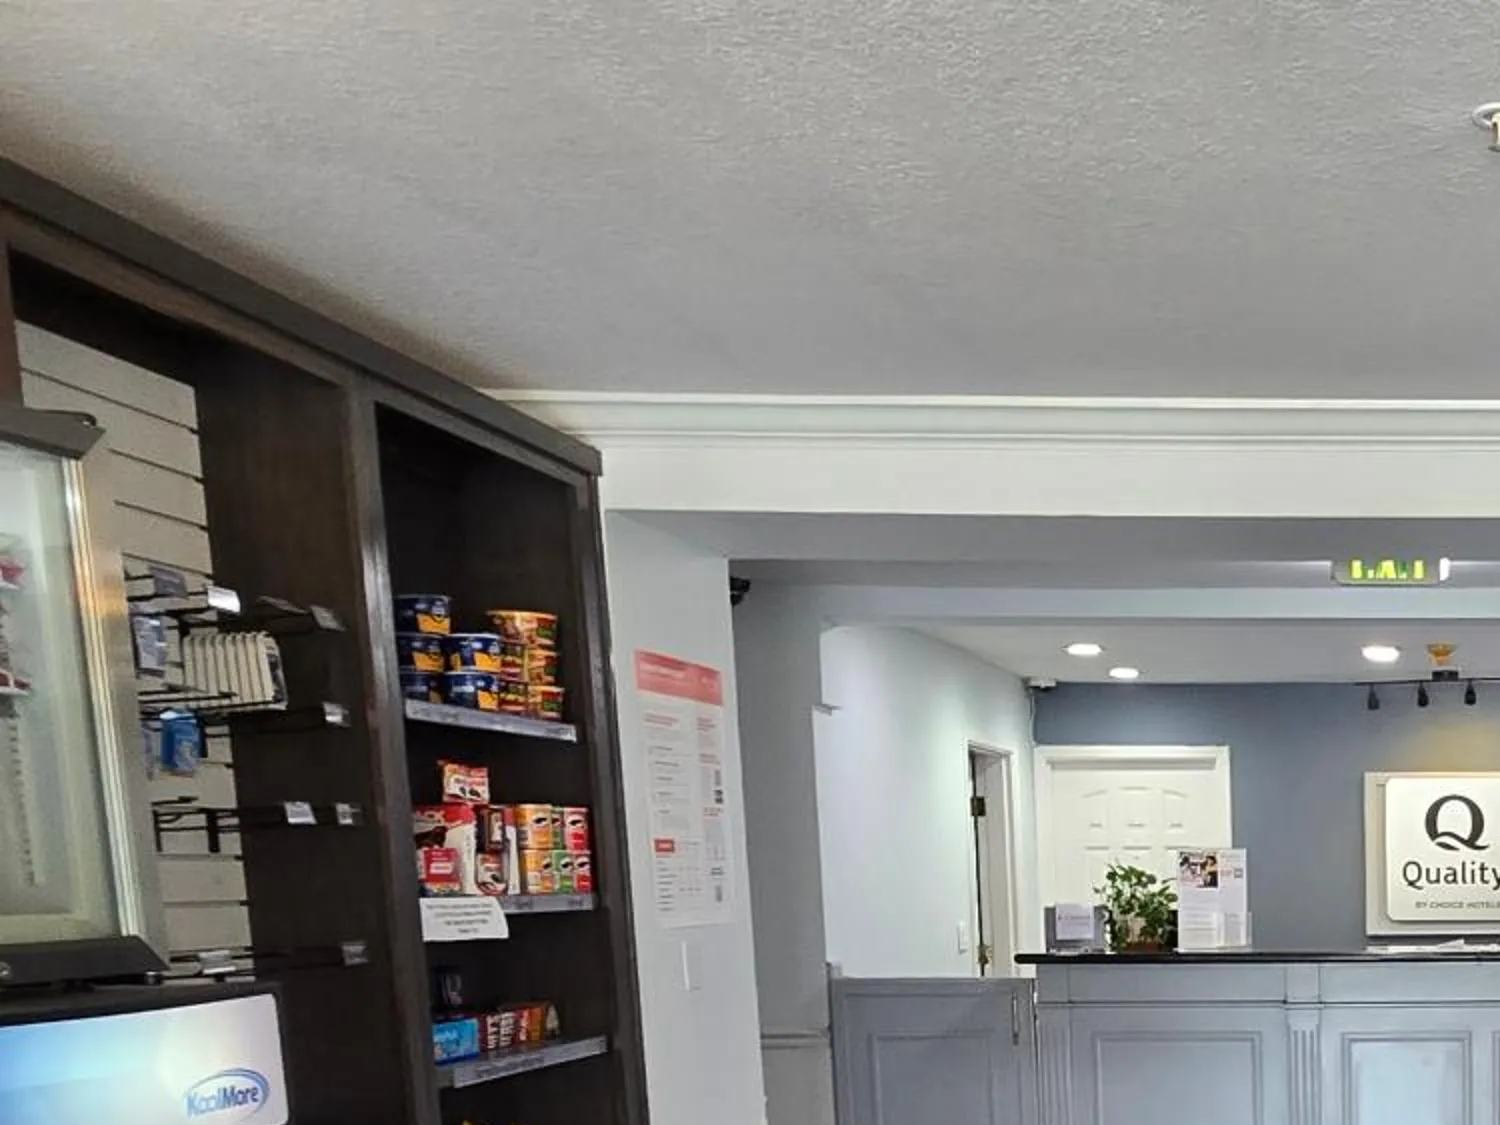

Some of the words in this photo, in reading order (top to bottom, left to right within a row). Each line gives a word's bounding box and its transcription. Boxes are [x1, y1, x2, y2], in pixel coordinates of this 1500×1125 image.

[1424, 794, 1490, 851] Q
[1429, 901, 1464, 909] CHOICE
[186, 1085, 259, 1118] KoolMore
